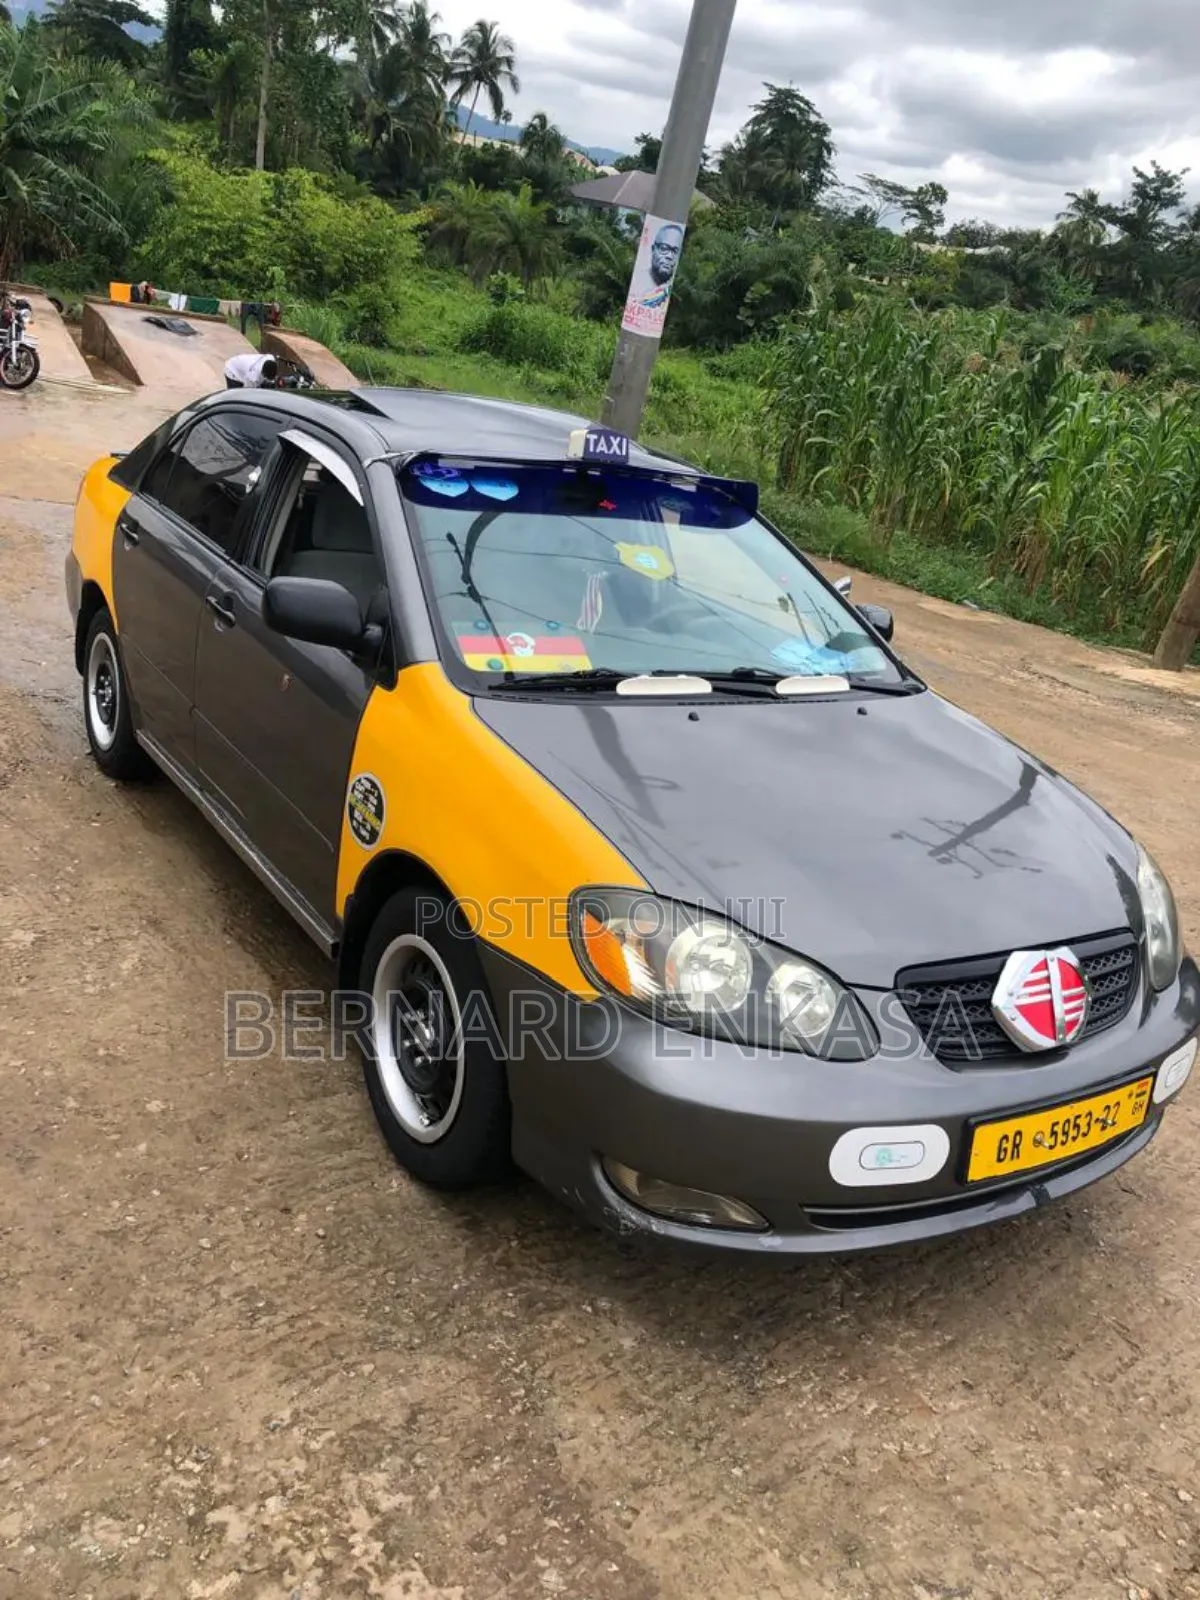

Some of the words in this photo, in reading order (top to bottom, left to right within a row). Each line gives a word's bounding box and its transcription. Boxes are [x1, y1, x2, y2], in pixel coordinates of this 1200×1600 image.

[586, 434, 627, 456] TAXI
[996, 1129, 1023, 1163] GR
[1048, 1101, 1121, 1150] 5953-22
